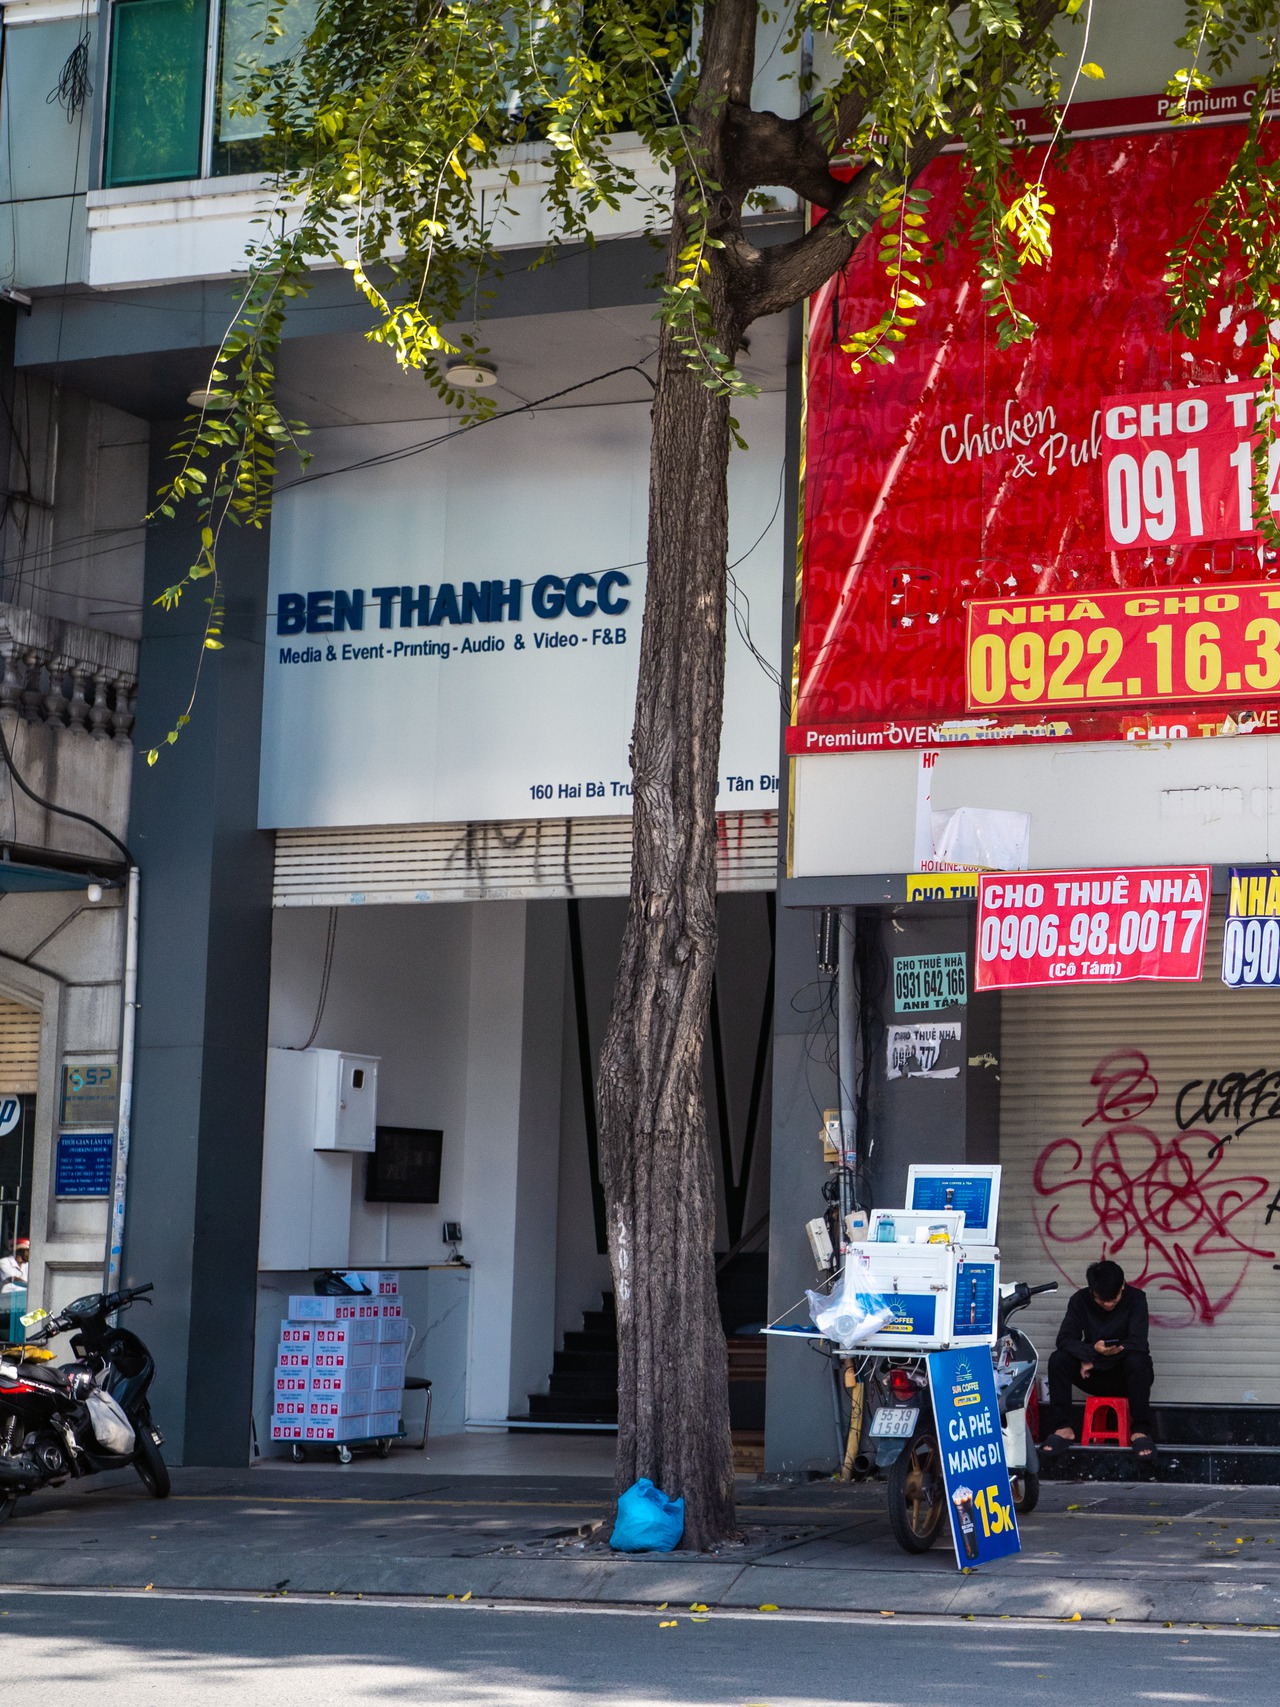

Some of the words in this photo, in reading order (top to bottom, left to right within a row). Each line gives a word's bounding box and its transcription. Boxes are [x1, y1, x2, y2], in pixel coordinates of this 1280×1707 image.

[1157, 93, 1237, 116] Prmium
[940, 399, 1057, 465] Chicken
[1105, 400, 1208, 441] CHO
[1012, 454, 1037, 478] &
[1106, 446, 1203, 545] 091
[276, 588, 364, 636] BEN
[371, 578, 522, 630] THANH
[531, 570, 631, 621] GCC
[988, 598, 1105, 625] NHÀ
[1124, 593, 1240, 617] CHO
[279, 643, 322, 665] Media
[325, 644, 338, 661] &
[342, 641, 385, 661] Event
[461, 635, 505, 654] Audio
[513, 633, 526, 650] &
[533, 630, 579, 649] Video
[592, 627, 627, 646] F&B
[806, 730, 883, 748] Premium
[889, 726, 940, 744] OVEN
[529, 784, 553, 800] 160
[558, 782, 582, 798] Hai
[586, 780, 605, 798] Bà
[726, 776, 754, 792] Tân
[760, 774, 780, 794] Đị
[984, 883, 1044, 909] CHO
[1054, 876, 1129, 906] THUÊ
[1139, 873, 1204, 904] NHÀ
[980, 909, 1203, 962] 0906.98.0017
[896, 960, 915, 971] CHO
[918, 956, 942, 969] THUÊ
[944, 954, 963, 968] NHÀ
[1049, 962, 1077, 979] (Cô
[1080, 961, 1122, 977] Tám)
[896, 971, 921, 999] 0931
[923, 969, 943, 998] 642
[946, 968, 965, 996] 166
[903, 1001, 929, 1010] ANH
[914, 1028, 937, 1041] THUÊ
[939, 1027, 956, 1041] NHÀ
[878, 1423, 909, 1435] 1590
[880, 1410, 913, 1422] 55-X9
[949, 1412, 965, 1442] CÀ
[969, 1407, 993, 1438] PHÊ
[948, 1446, 987, 1475] MANG
[988, 1442, 1002, 1466] ĐI
